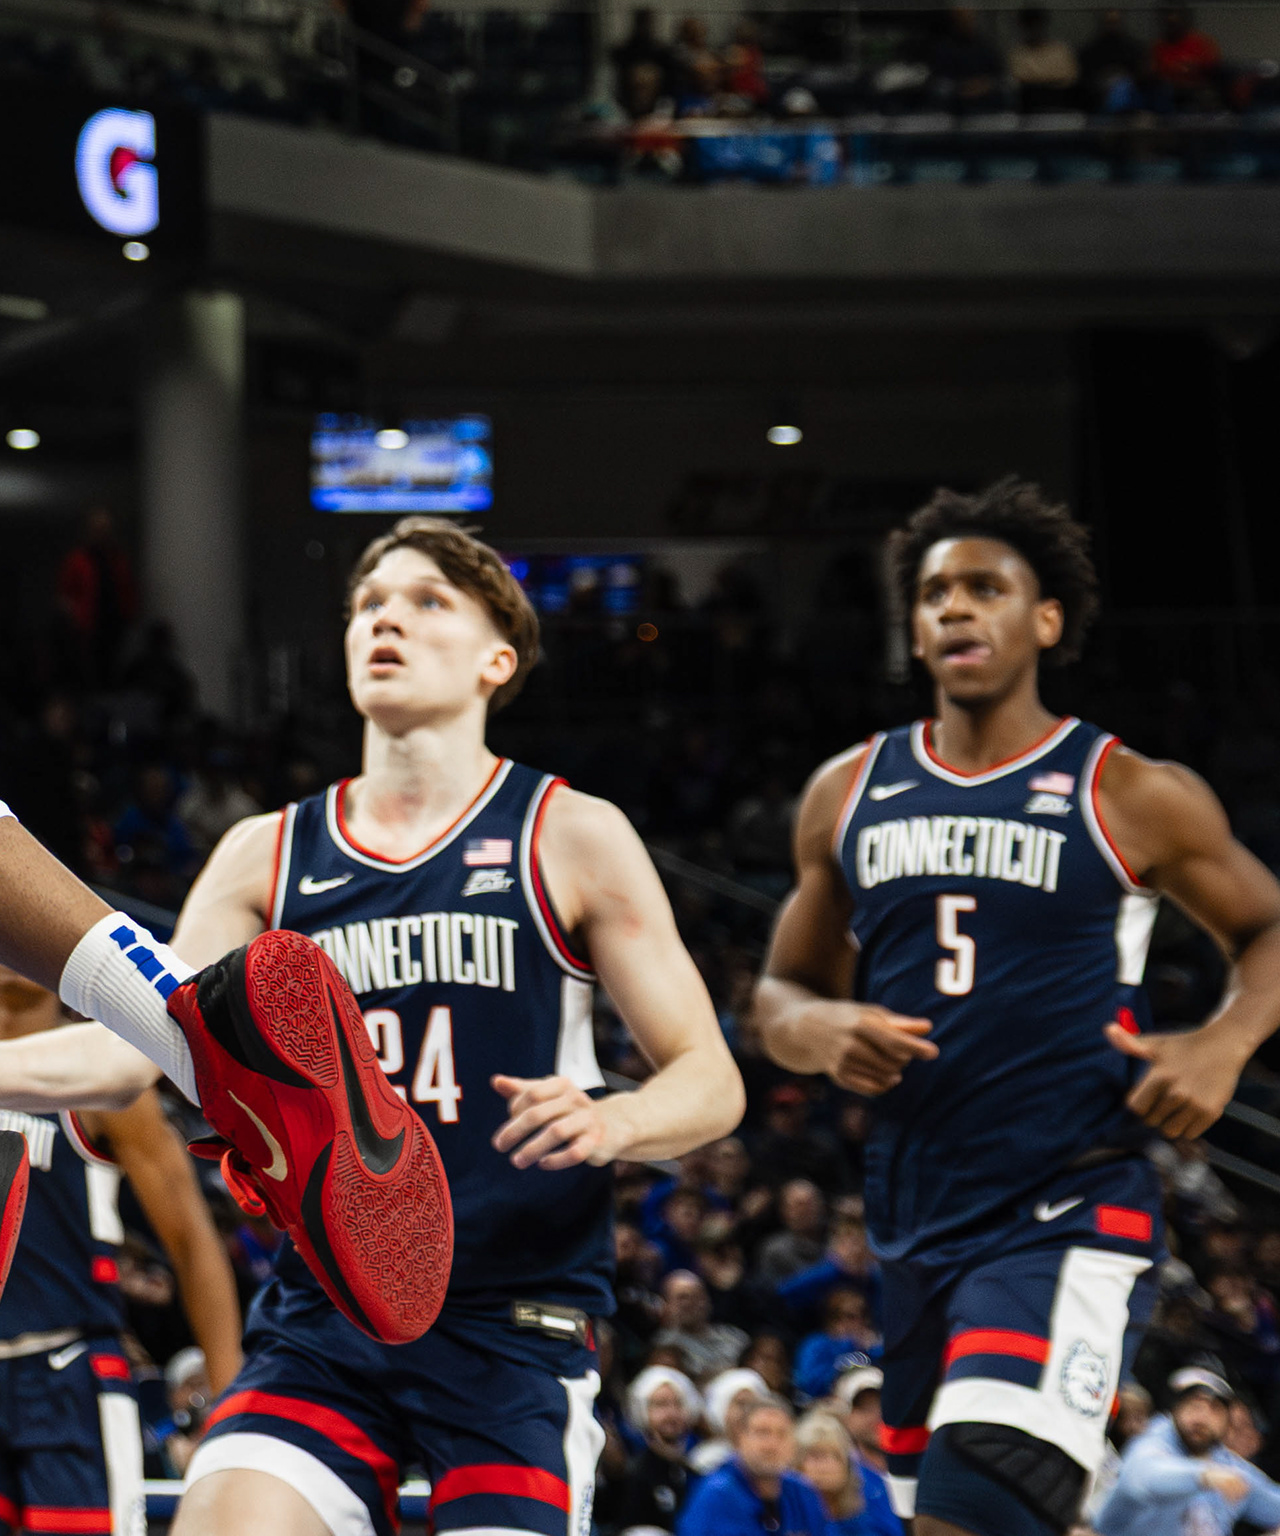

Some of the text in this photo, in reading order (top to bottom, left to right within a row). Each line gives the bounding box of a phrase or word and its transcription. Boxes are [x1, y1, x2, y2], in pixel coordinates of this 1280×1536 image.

[75, 106, 160, 238] G
[856, 815, 1068, 893] CONNECTICUT
[934, 893, 977, 997] 5
[363, 1005, 464, 1124] 24
